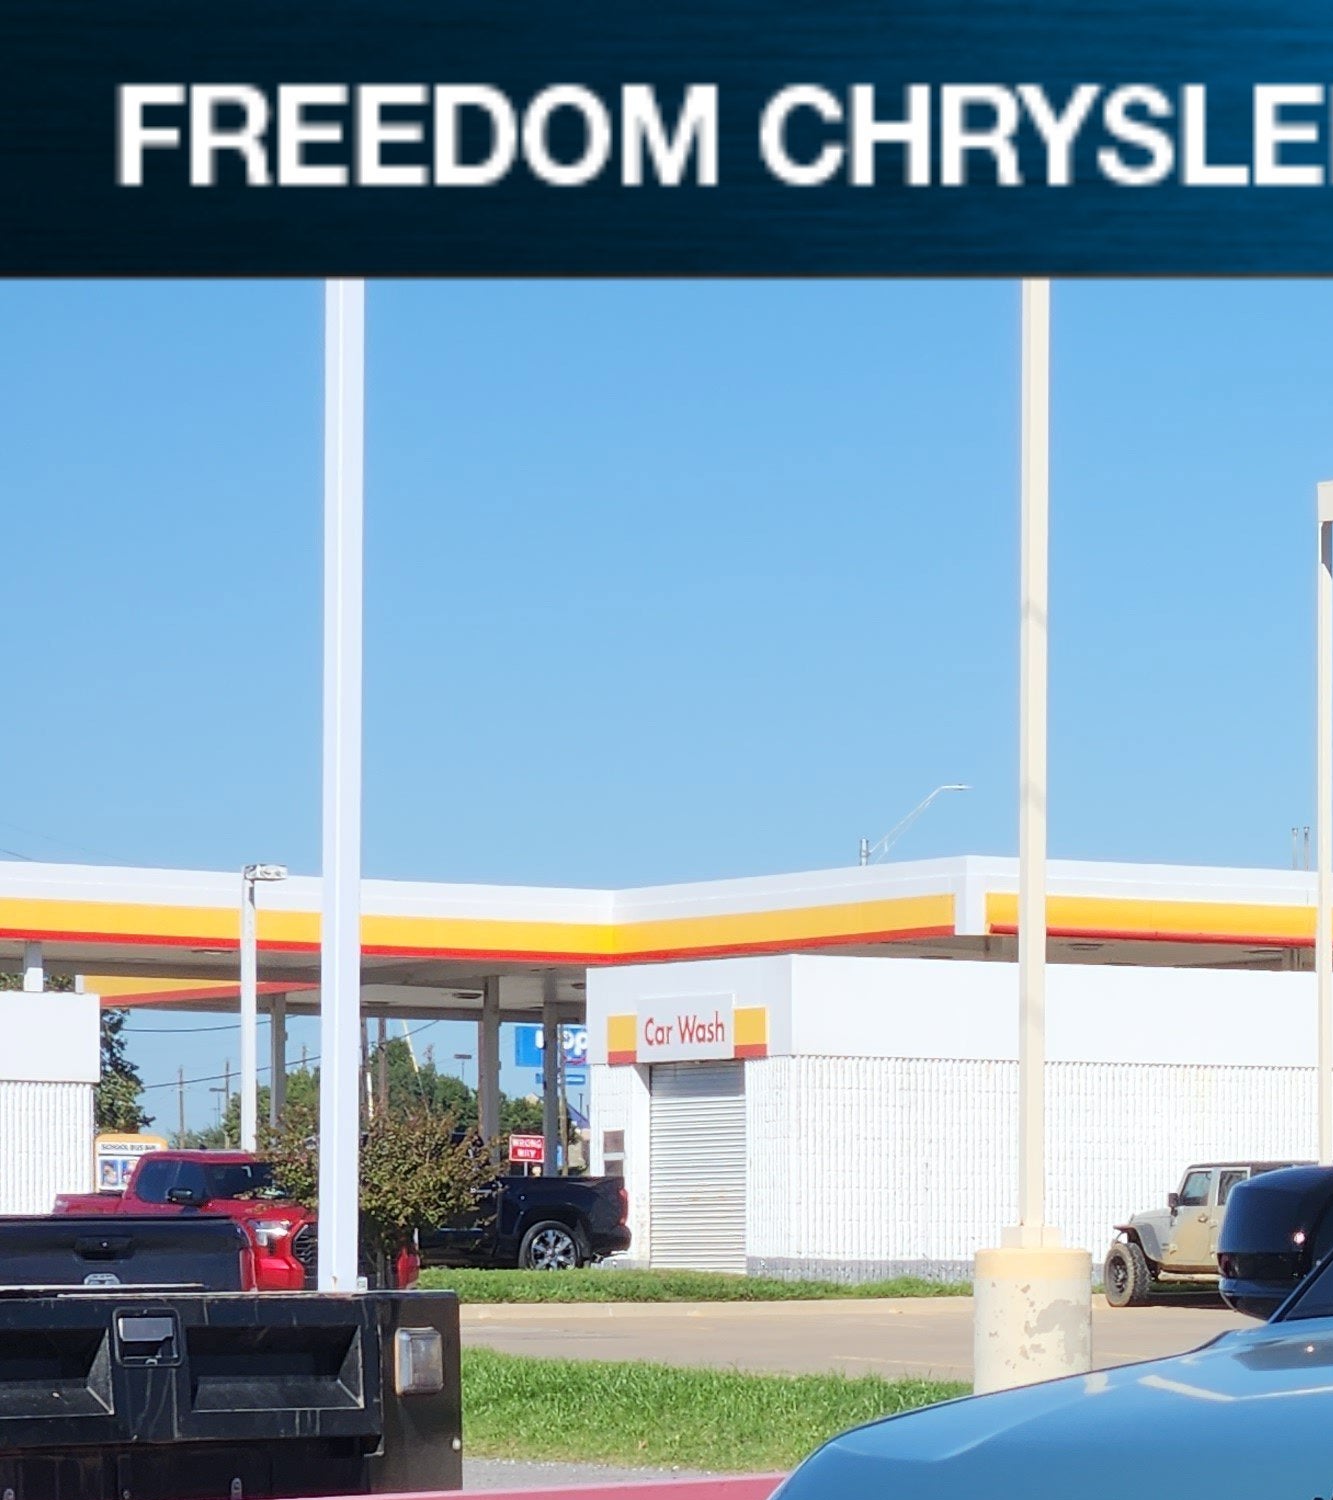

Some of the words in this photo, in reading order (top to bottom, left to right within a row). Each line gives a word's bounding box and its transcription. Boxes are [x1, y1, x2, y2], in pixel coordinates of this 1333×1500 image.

[644, 1017, 673, 1047] Car
[677, 1010, 726, 1044] Wash
[512, 1138, 542, 1149] WRONG
